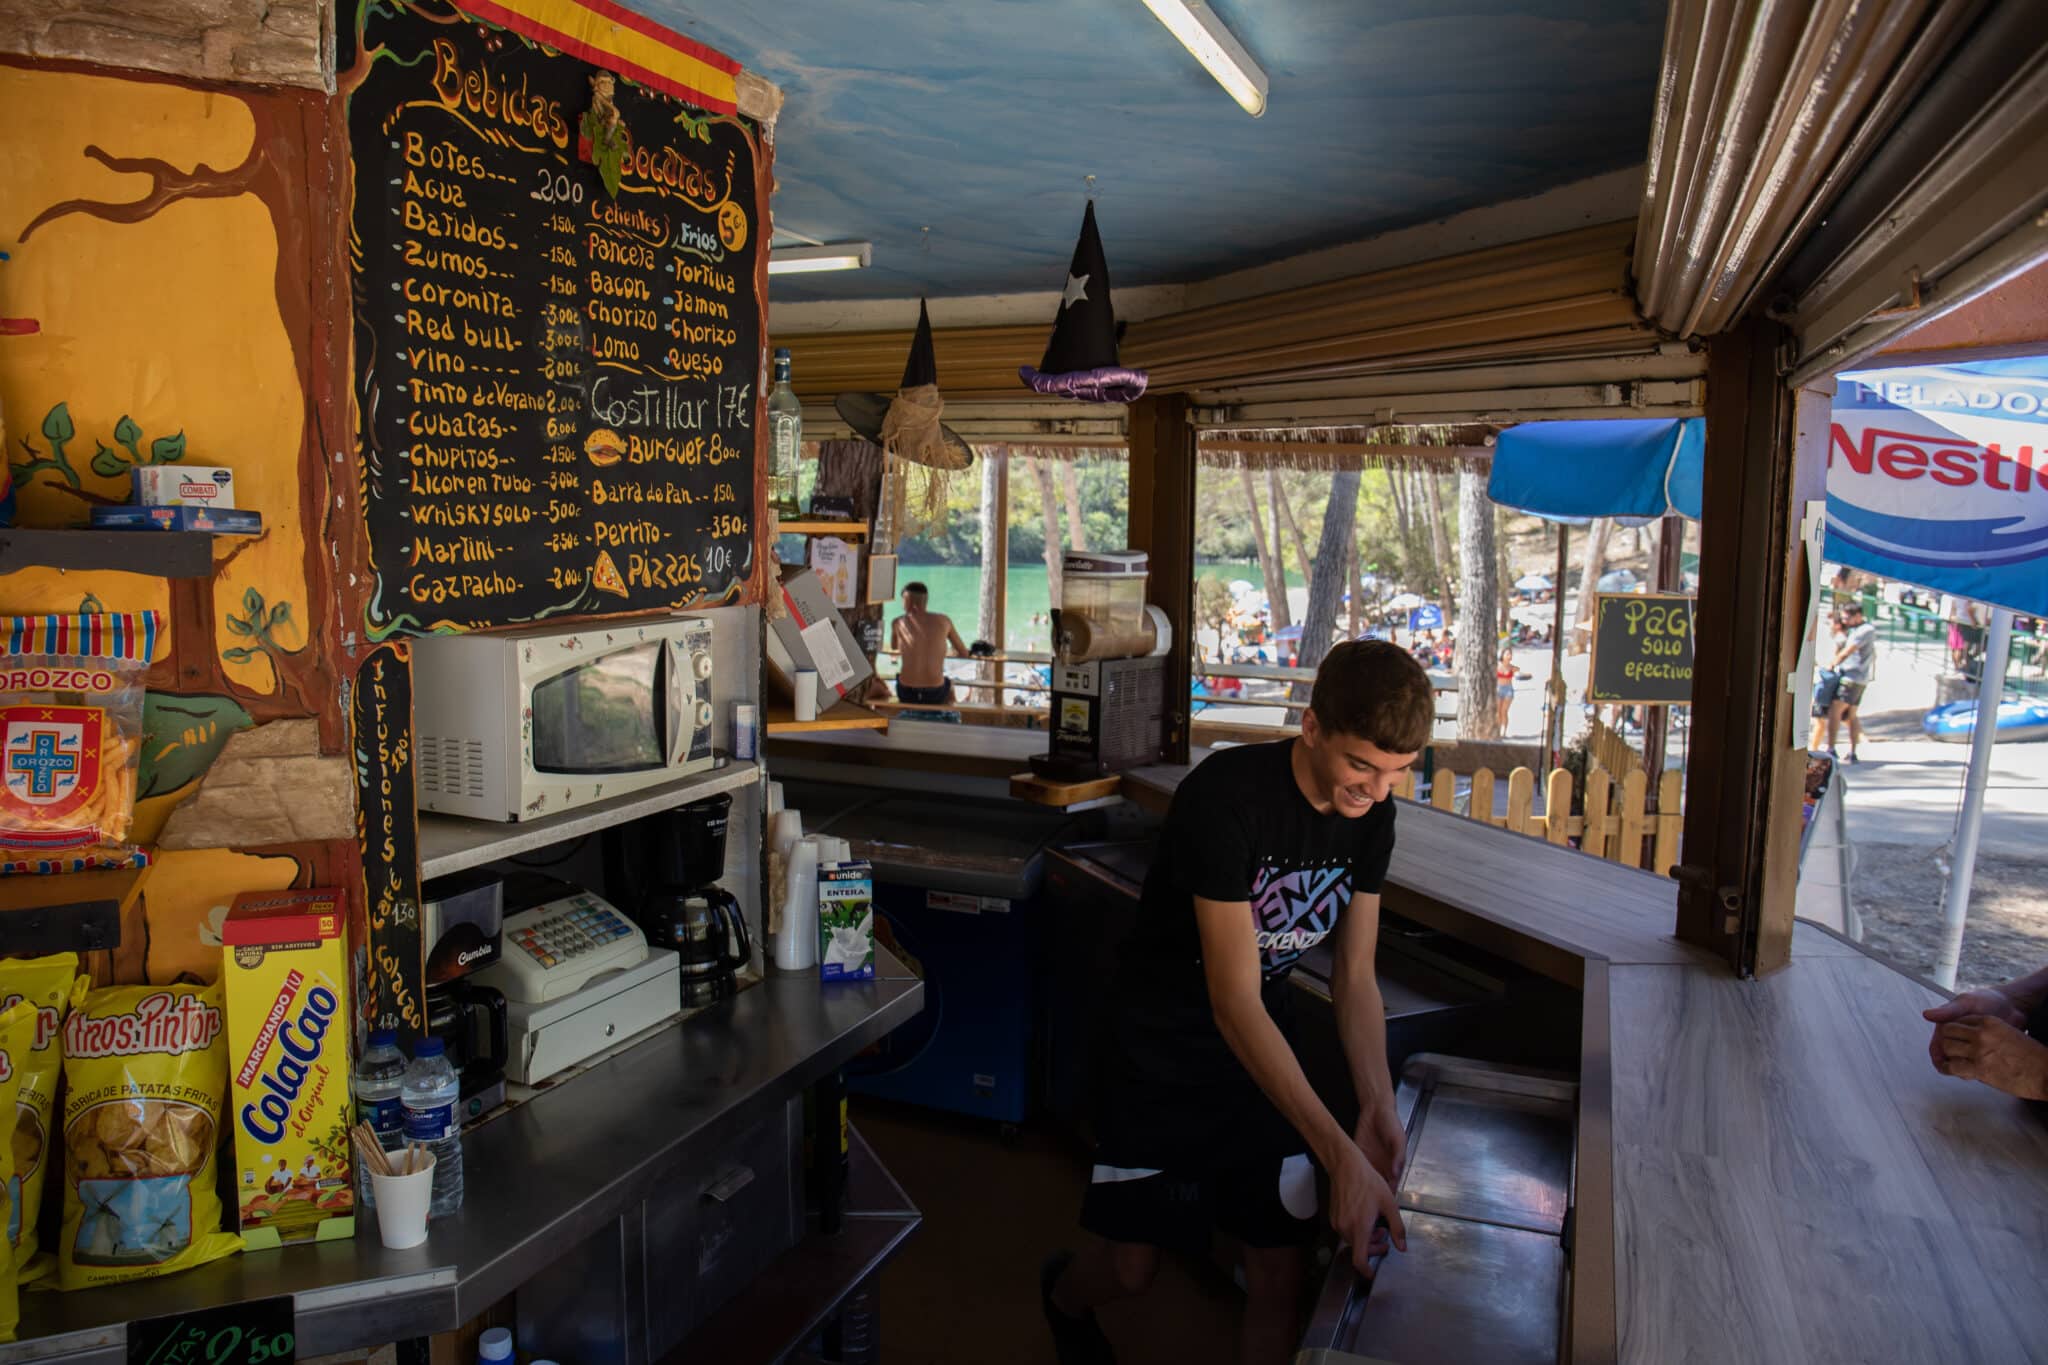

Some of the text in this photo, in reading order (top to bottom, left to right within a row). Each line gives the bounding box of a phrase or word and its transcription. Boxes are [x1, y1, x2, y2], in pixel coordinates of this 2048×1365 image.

[432, 38, 568, 148] Bebidas
[404, 201, 506, 249] Batidos
[681, 222, 717, 251] Frios
[403, 240, 488, 279] Zumos
[589, 232, 655, 270] Panceta
[590, 270, 650, 301] Bacon
[673, 256, 736, 294] Tortilla
[404, 278, 516, 318] Coronita
[674, 289, 729, 320] Jamon
[406, 309, 455, 340] Red
[464, 320, 514, 351] bull
[588, 299, 657, 331] Chorizo
[592, 332, 640, 360] Lomo
[671, 317, 737, 347] Chorizo
[408, 347, 465, 373] Vino
[669, 348, 723, 375] Queso
[408, 378, 467, 403] Tinto
[473, 385, 495, 406] de
[493, 381, 545, 411] Verano
[592, 376, 750, 430] Costillar 17€
[408, 410, 502, 438] Cubatas
[410, 443, 498, 470] Chupitos
[628, 434, 705, 465] Burguer
[1828, 422, 2048, 493] Nestl
[411, 469, 465, 496] Licor
[467, 476, 487, 495] en
[490, 473, 531, 493] Tubo
[592, 479, 643, 505] Barra
[647, 481, 664, 504] de
[666, 482, 693, 505] Pan
[594, 518, 660, 547] Perrito
[411, 536, 495, 567] Martini
[628, 546, 732, 590] Pizzas 10€
[1625, 600, 1696, 637] PaG
[1625, 661, 1692, 682] efectivo
[17, 758, 73, 767] OROZCO
[37, 737, 48, 792] OROZCO
[827, 889, 865, 897] ENTERA
[1256, 929, 1331, 950] CKENZIE
[141, 995, 219, 1049] Pintor
[241, 986, 337, 1145] ColaCao
[64, 1083, 219, 1117] ABRICA DE PATATAS FRITAS
